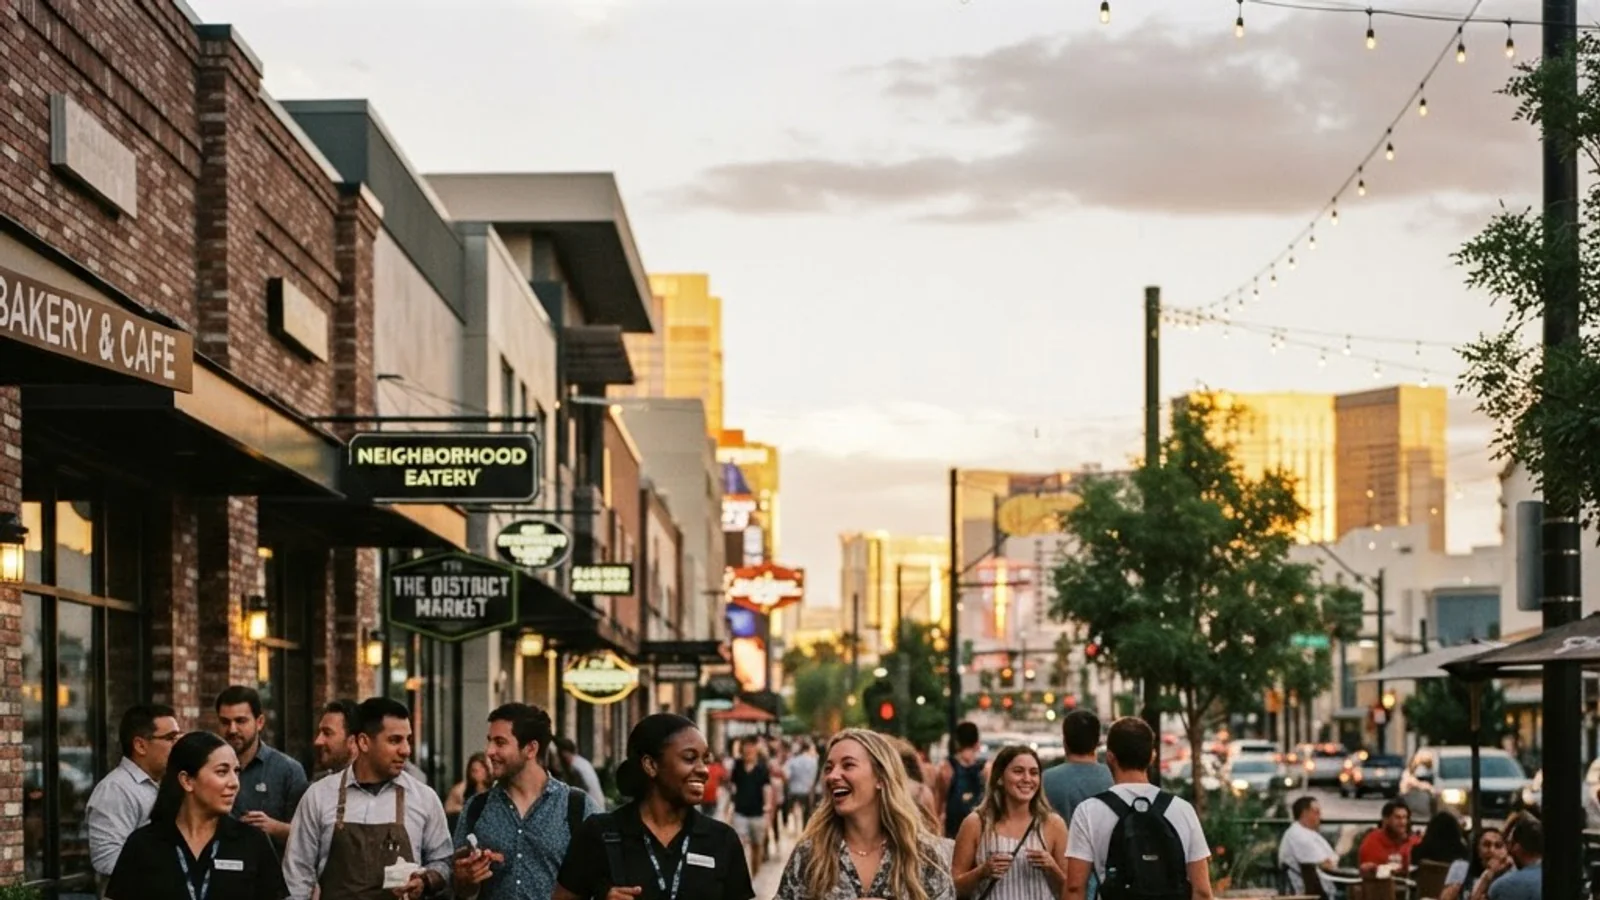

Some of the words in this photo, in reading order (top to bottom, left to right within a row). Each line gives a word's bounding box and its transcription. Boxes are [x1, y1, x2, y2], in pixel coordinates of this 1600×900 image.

[0, 275, 92, 354] BAKERY
[99, 312, 115, 363] &
[121, 320, 176, 380] CAFE
[357, 447, 527, 465] NEIGHBORHOOD
[404, 468, 482, 486] EATERY
[392, 575, 426, 597] THE
